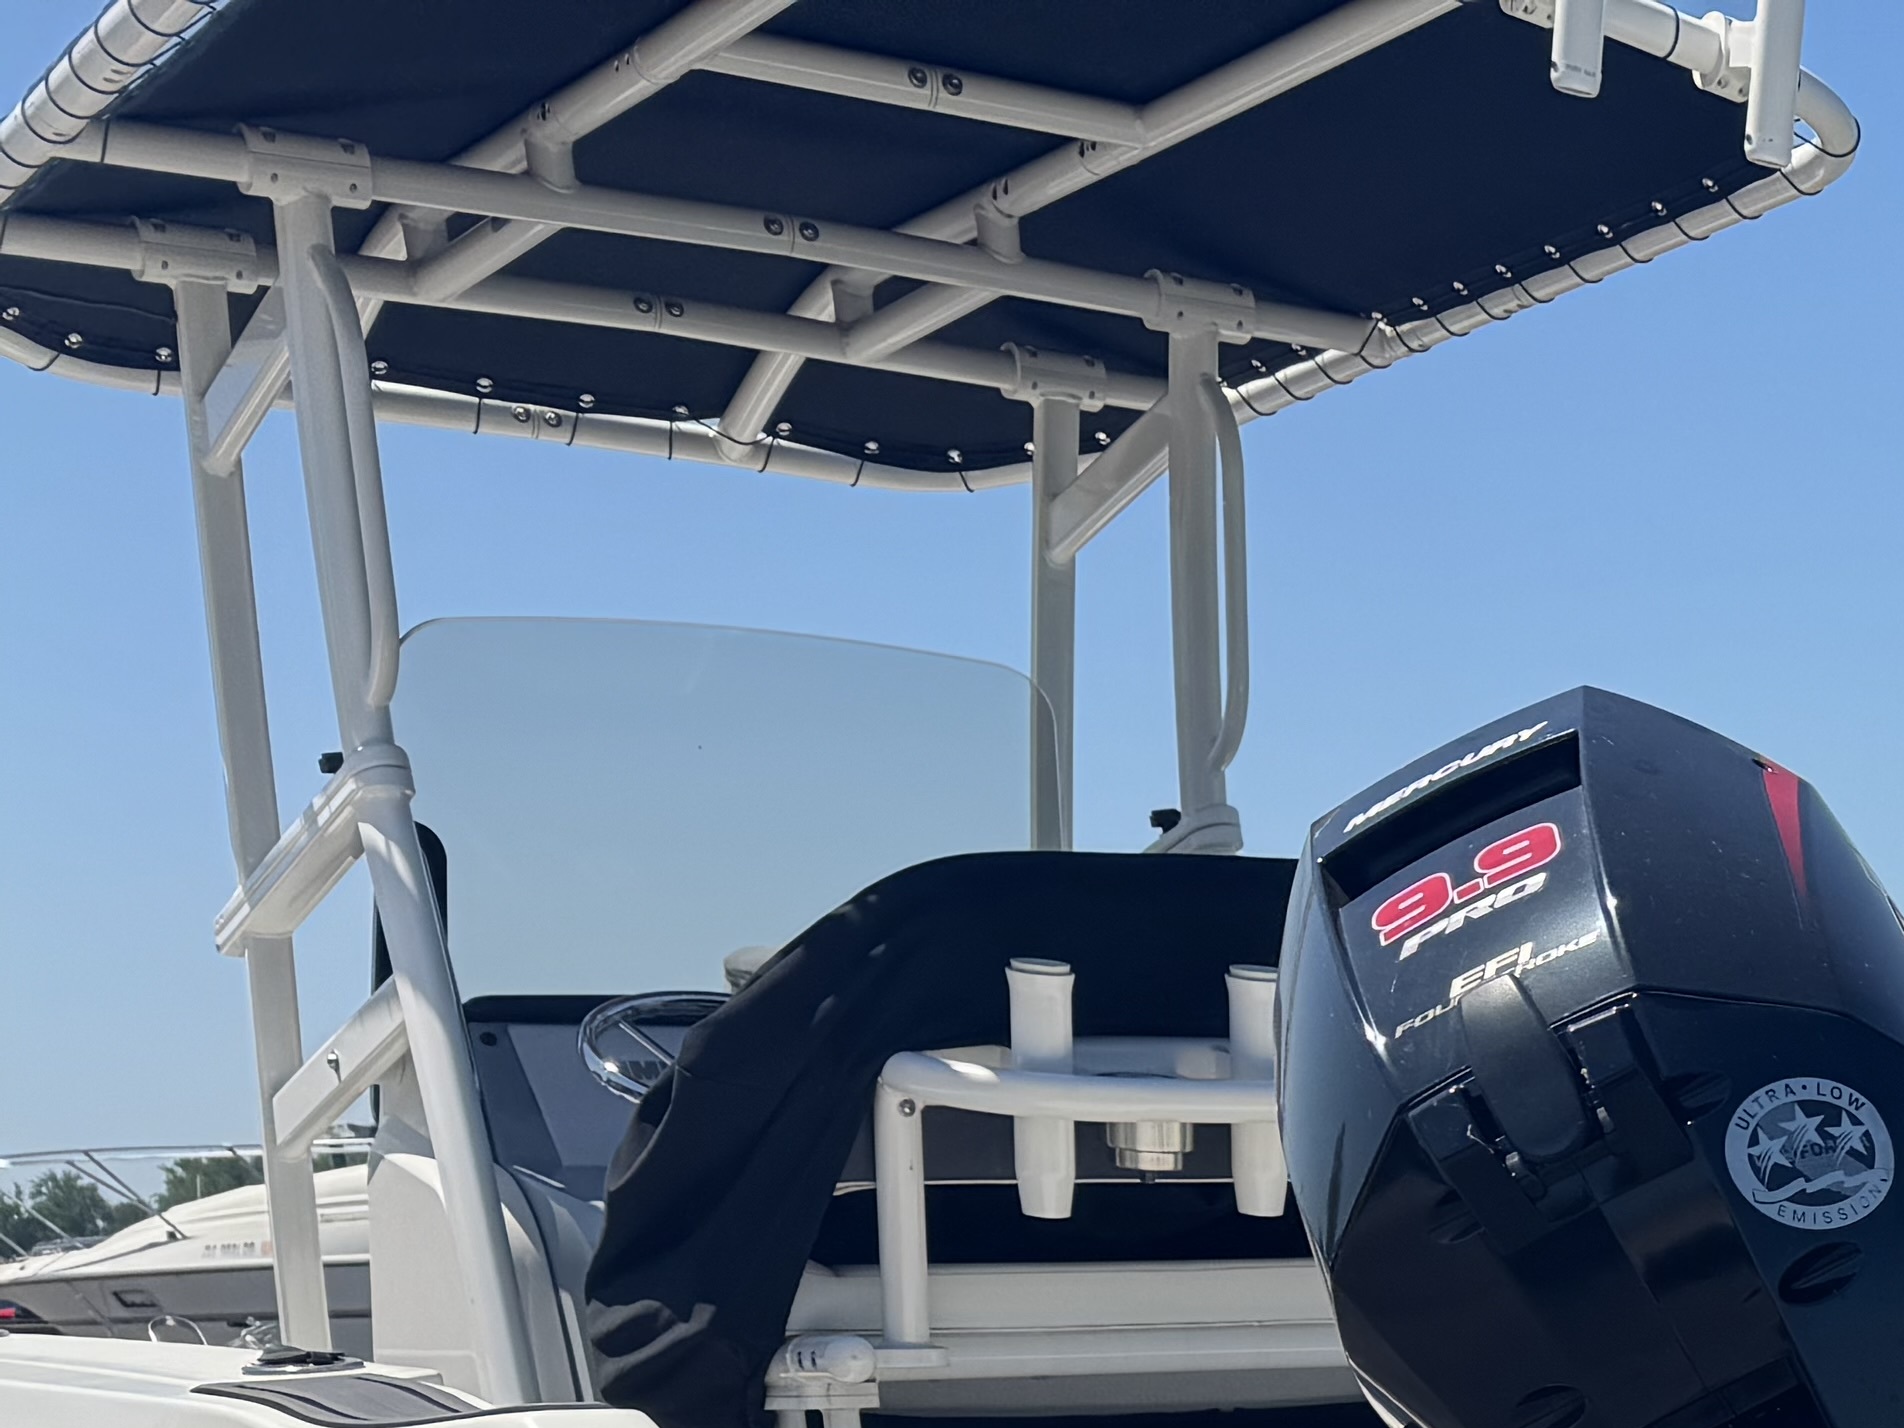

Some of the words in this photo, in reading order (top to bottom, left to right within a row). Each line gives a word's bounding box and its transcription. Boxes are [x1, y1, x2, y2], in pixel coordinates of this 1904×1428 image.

[1343, 721, 1548, 833] MERCURY
[1371, 822, 1561, 946] 9.9
[1399, 872, 1547, 960] PRO
[1450, 942, 1534, 999] EFI
[1735, 1083, 1797, 1131] ULTRA
[1816, 1082, 1866, 1111] LOW
[1777, 1182, 1883, 1224] EMISSION
